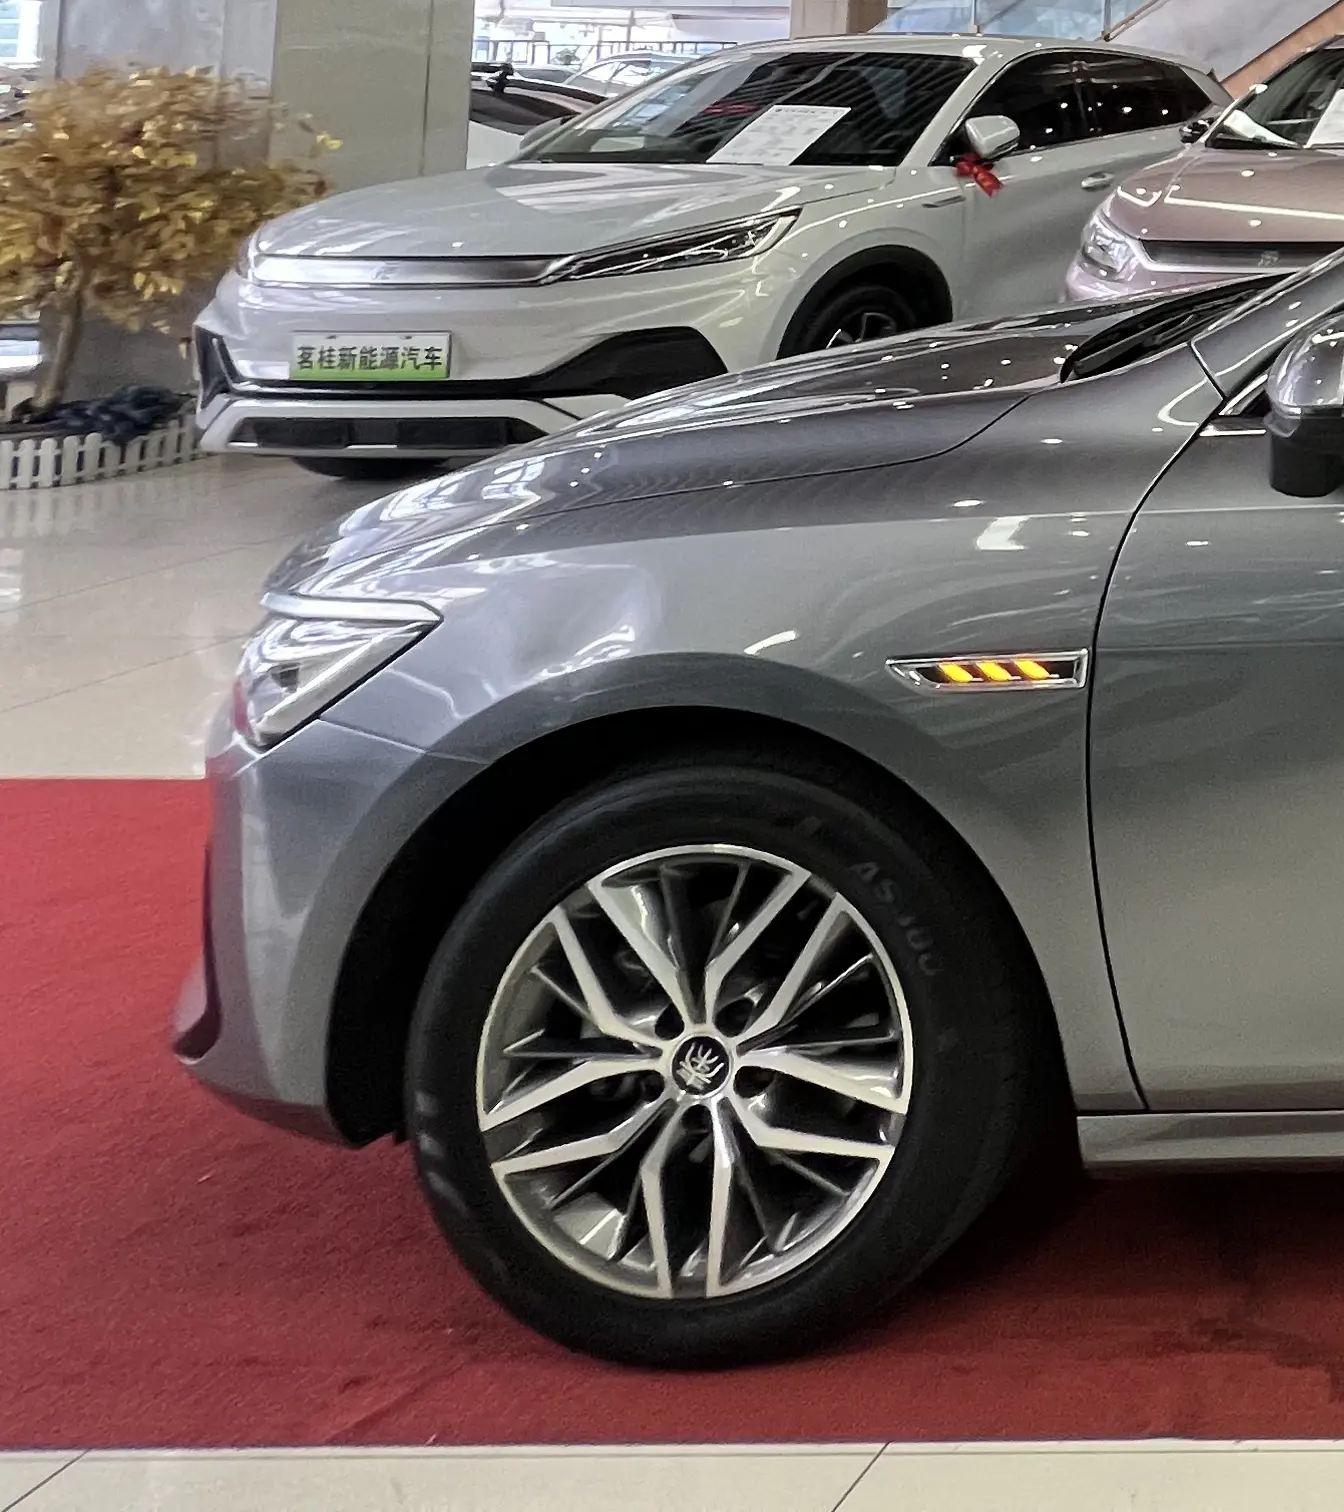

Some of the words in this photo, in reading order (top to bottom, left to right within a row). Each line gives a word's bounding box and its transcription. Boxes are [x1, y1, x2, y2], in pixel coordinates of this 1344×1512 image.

[297, 345, 443, 371] 茗桂新能源汽车
